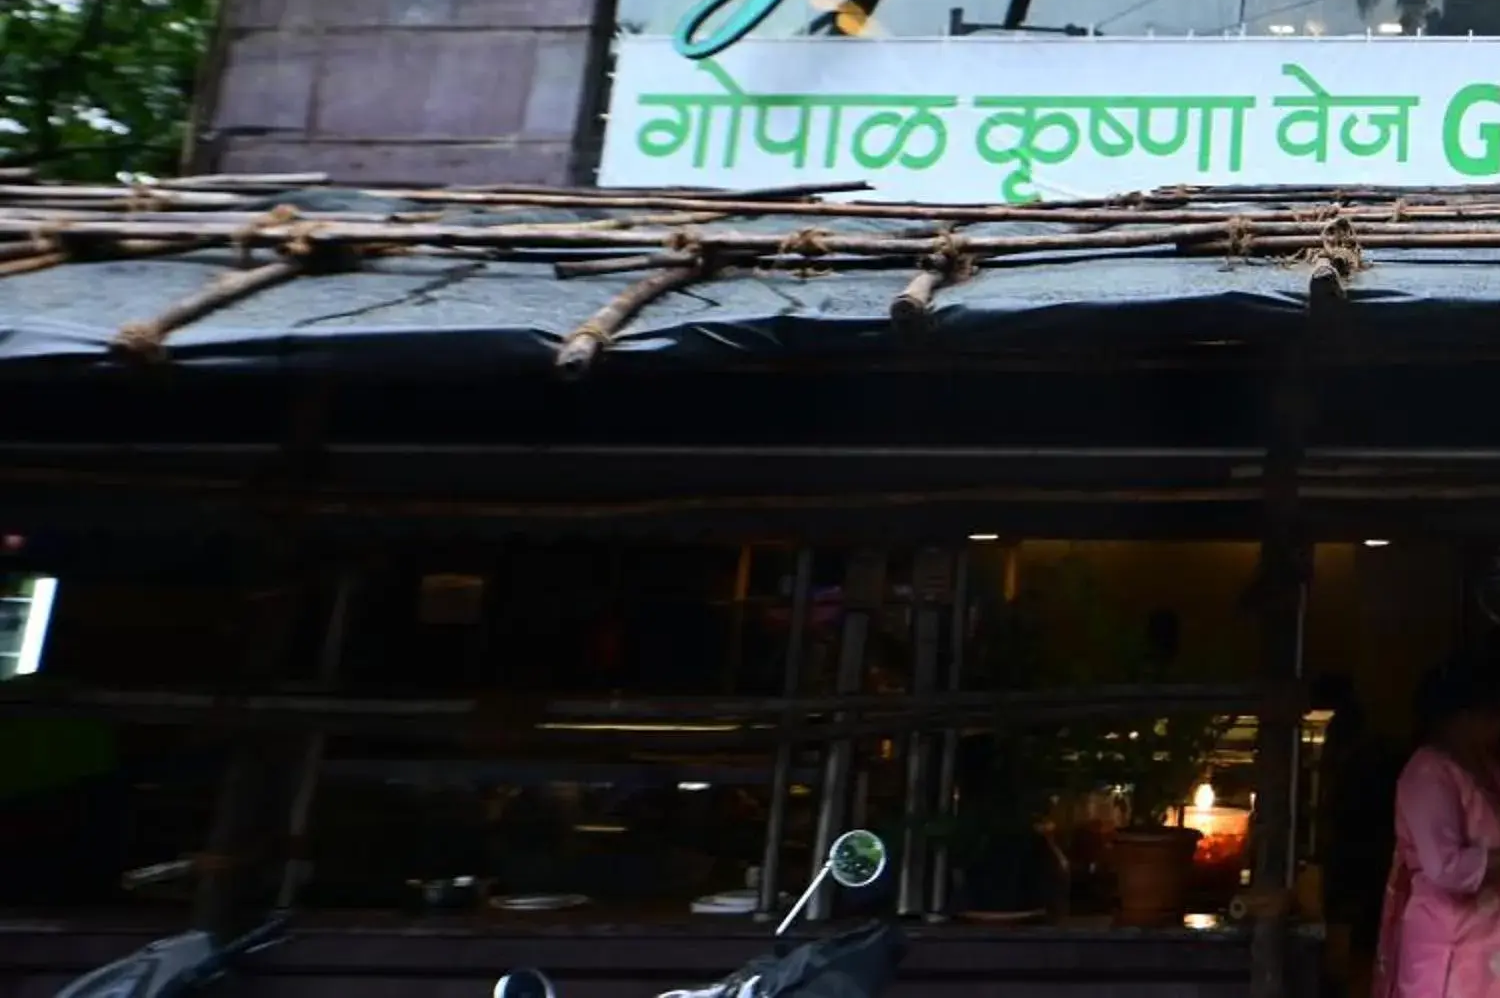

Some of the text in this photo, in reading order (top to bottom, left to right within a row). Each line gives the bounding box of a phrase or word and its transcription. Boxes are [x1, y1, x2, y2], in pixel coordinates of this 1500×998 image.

[636, 57, 1420, 205] गोपाळ कृष्णा वेज
